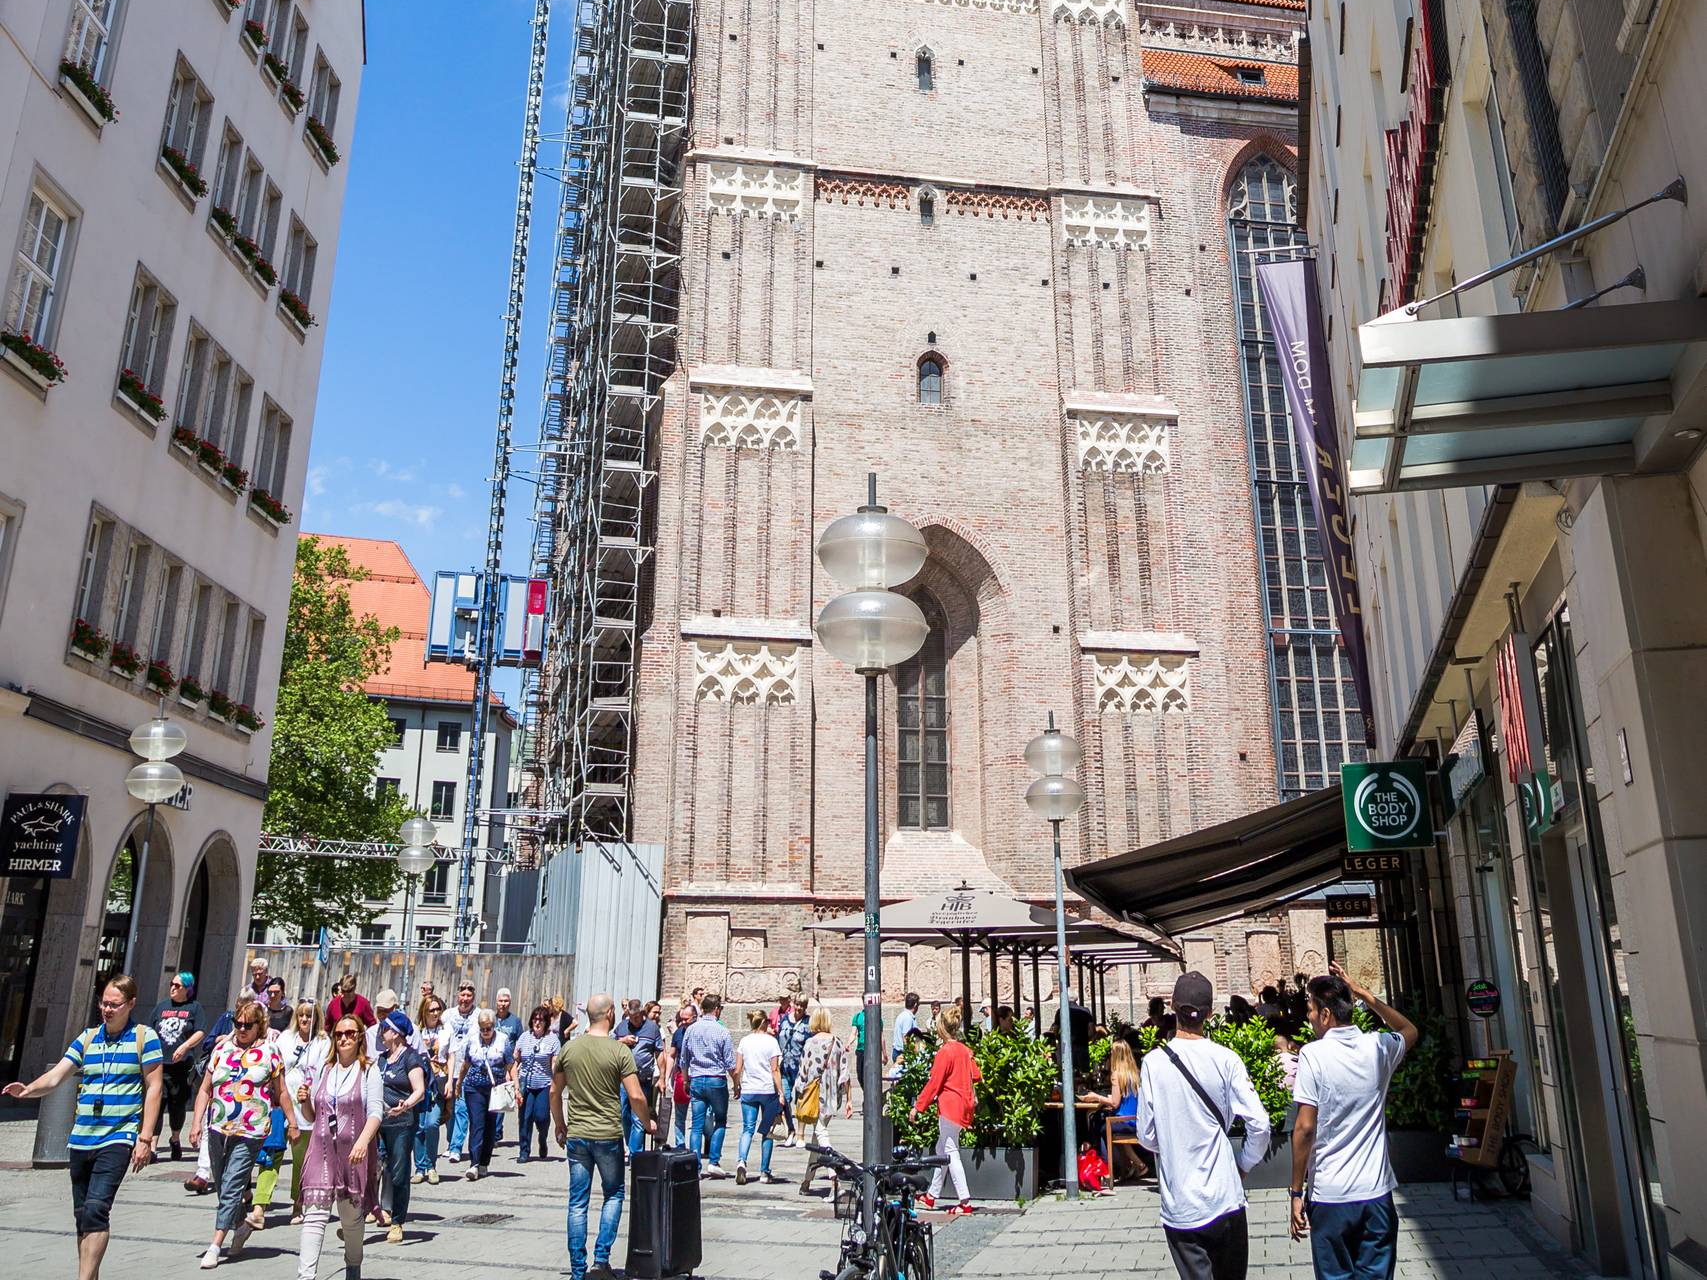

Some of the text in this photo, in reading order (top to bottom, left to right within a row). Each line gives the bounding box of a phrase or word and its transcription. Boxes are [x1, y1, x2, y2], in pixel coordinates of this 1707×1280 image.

[1374, 792, 1398, 803] THE
[10, 803, 36, 823] PAUL
[45, 801, 75, 825] SHARK
[1367, 802, 1408, 816] BODY
[1371, 814, 1408, 827] SHOP
[13, 839, 63, 853] yachting
[8, 858, 62, 872] HIRMER
[1344, 856, 1400, 870] LEGER
[1328, 900, 1369, 912] LEGER
